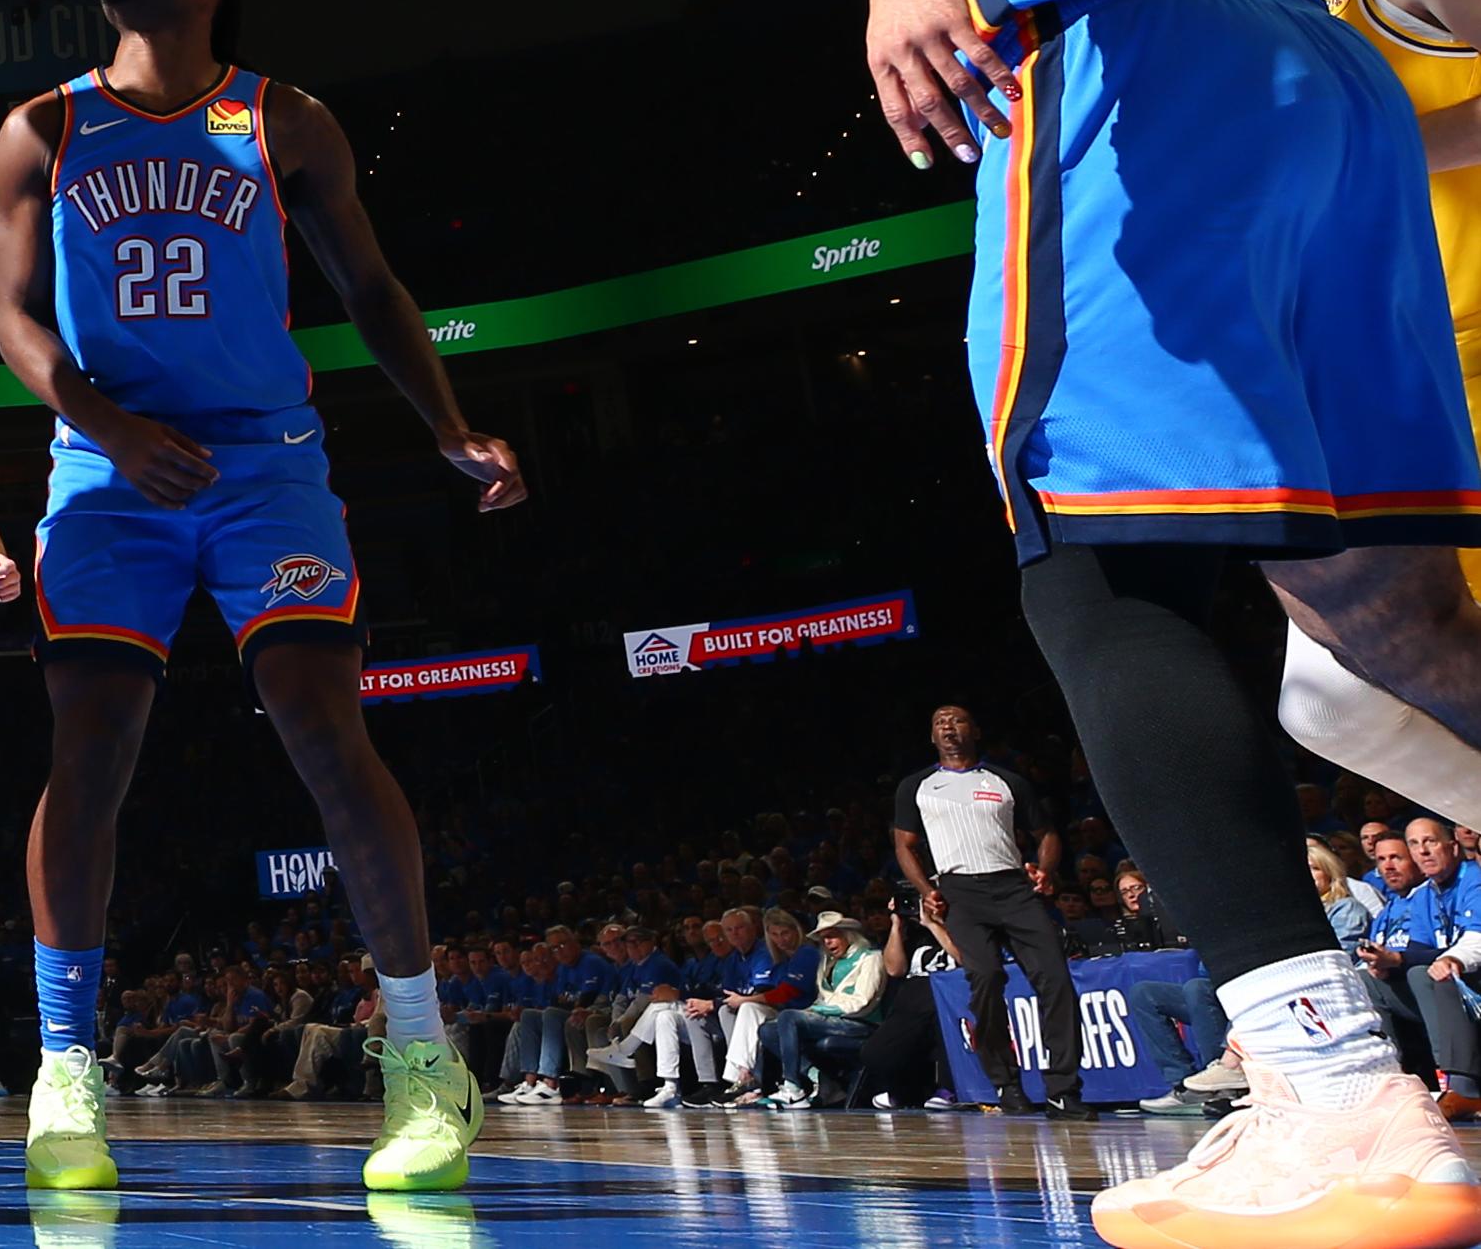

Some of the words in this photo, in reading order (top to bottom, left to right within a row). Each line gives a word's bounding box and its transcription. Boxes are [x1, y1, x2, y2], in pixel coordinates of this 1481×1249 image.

[48, 3, 109, 60] CIT
[67, 157, 259, 234] THUNDER
[811, 236, 881, 272] Sprite
[114, 235, 210, 319] 22
[426, 318, 477, 344] prite
[276, 563, 322, 591] OKC
[703, 630, 754, 654] BUILT
[758, 625, 795, 646] FOR
[797, 608, 894, 639] GREATNESS!
[378, 670, 415, 690] FOR
[416, 660, 517, 686] GREATNESS!
[635, 650, 680, 667] HOME
[1014, 988, 1136, 1070] PLFFS
